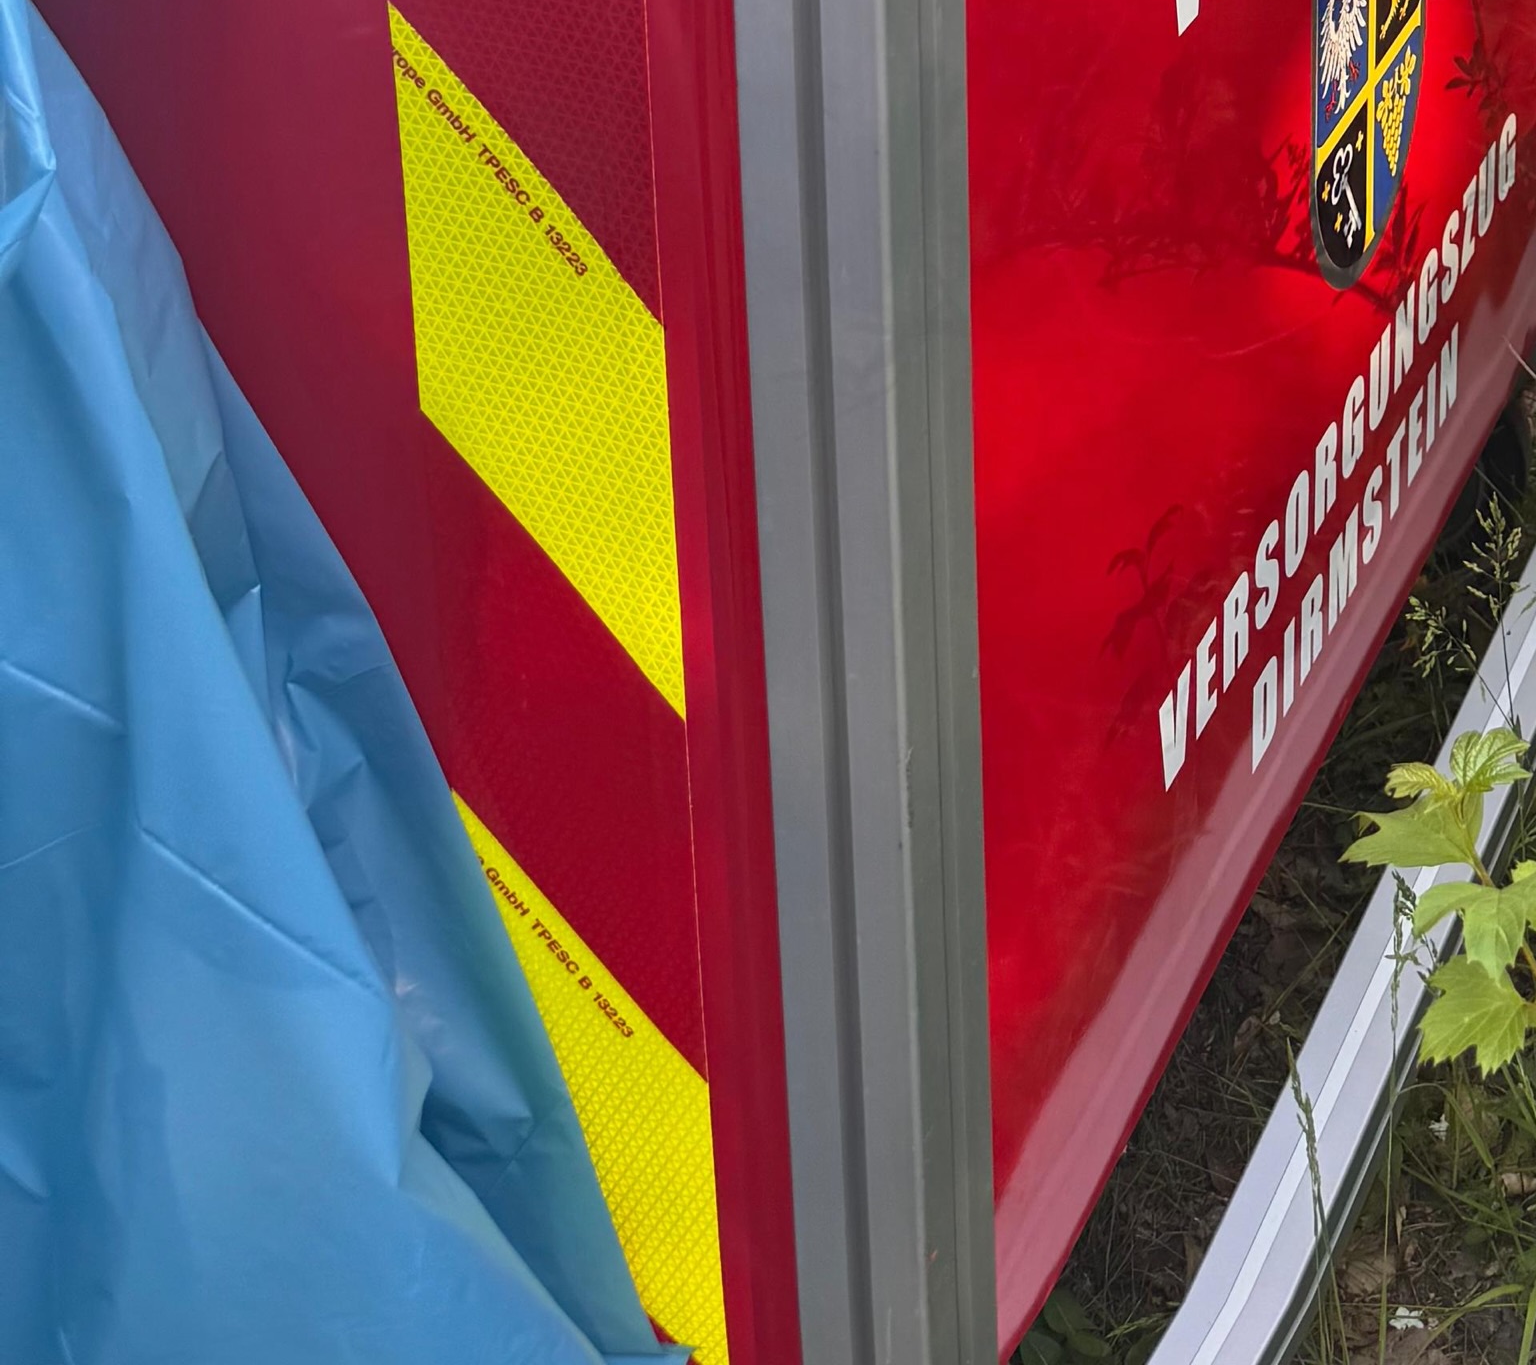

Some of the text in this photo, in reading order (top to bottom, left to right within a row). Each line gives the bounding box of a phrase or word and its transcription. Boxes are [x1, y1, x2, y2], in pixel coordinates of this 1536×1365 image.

[427, 89, 477, 144] GmbH
[477, 143, 531, 206] TPESC
[529, 205, 545, 225] B
[544, 224, 589, 277] 13223
[1158, 112, 1519, 792] VERSORGUNGSZUG
[1251, 321, 1460, 774] DIRMSTEIN
[485, 866, 635, 1039] GmbH TPESC B 13223
